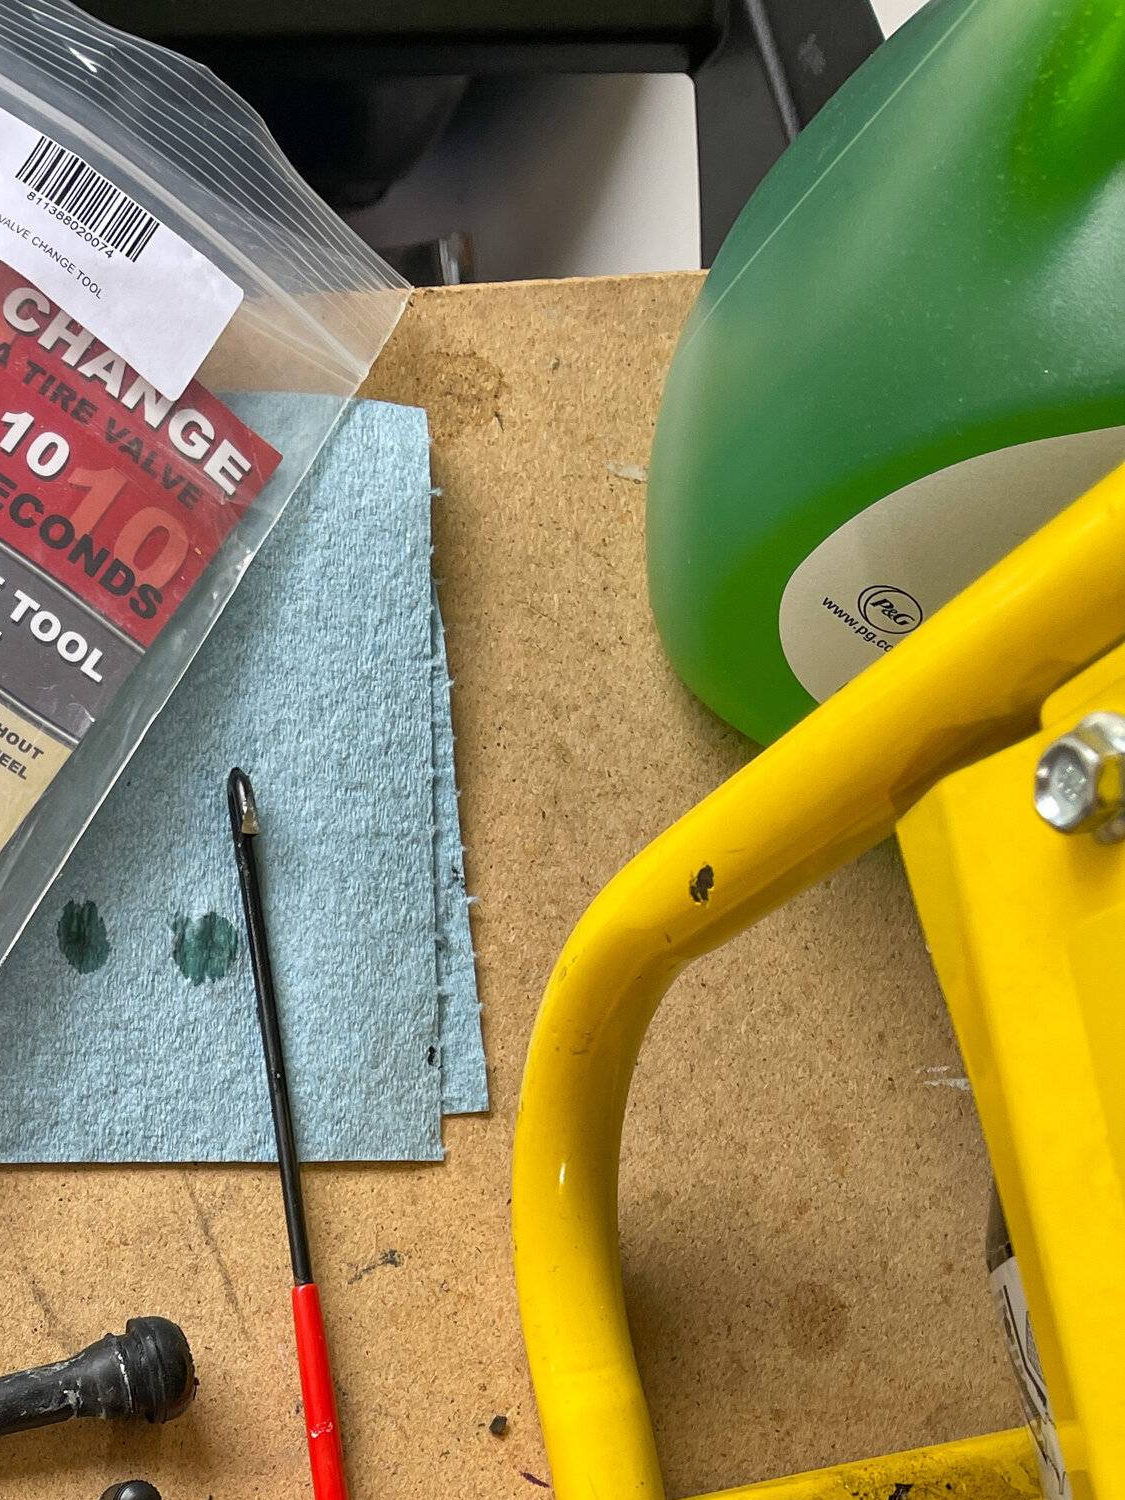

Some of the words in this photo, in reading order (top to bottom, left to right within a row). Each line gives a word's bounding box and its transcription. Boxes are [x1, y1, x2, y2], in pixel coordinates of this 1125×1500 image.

[25, 191, 117, 258] 811388020074
[30, 235, 77, 274] CHANGE
[75, 269, 103, 299] TOOL
[3, 288, 249, 492] CHANGE
[0, 411, 69, 476] 10
[21, 361, 99, 425] TIRE
[93, 417, 203, 510] VALVE
[67, 466, 189, 589] 10
[10, 590, 102, 681] TOOL
[869, 598, 915, 626] P&G
